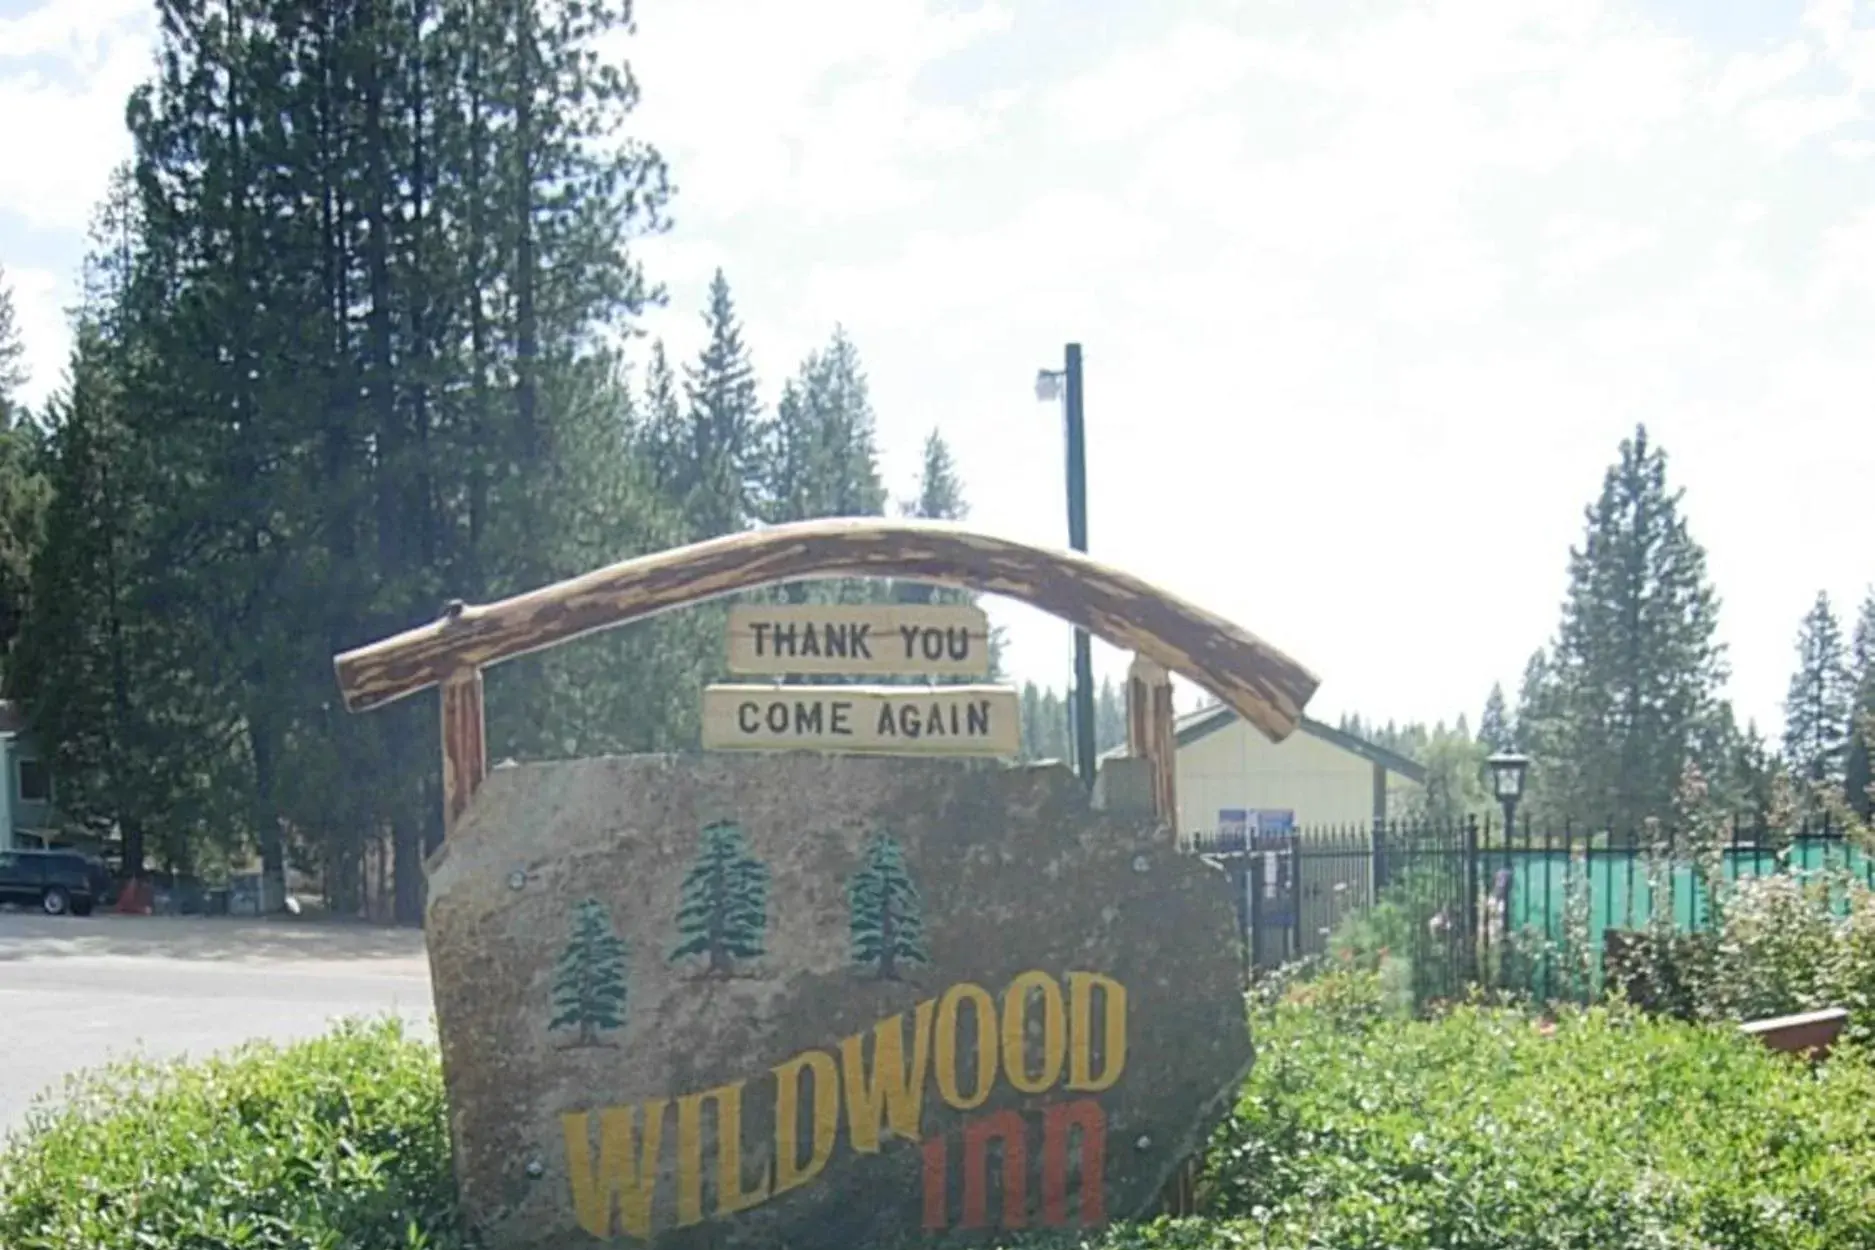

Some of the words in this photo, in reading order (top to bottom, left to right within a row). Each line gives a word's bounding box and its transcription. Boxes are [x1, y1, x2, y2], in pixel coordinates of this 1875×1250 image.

[749, 622, 872, 659] THANK
[901, 625, 970, 660] YOU
[738, 702, 852, 735] COME
[877, 701, 992, 738] AGAIN
[561, 969, 1128, 1241] WILDWOOD
